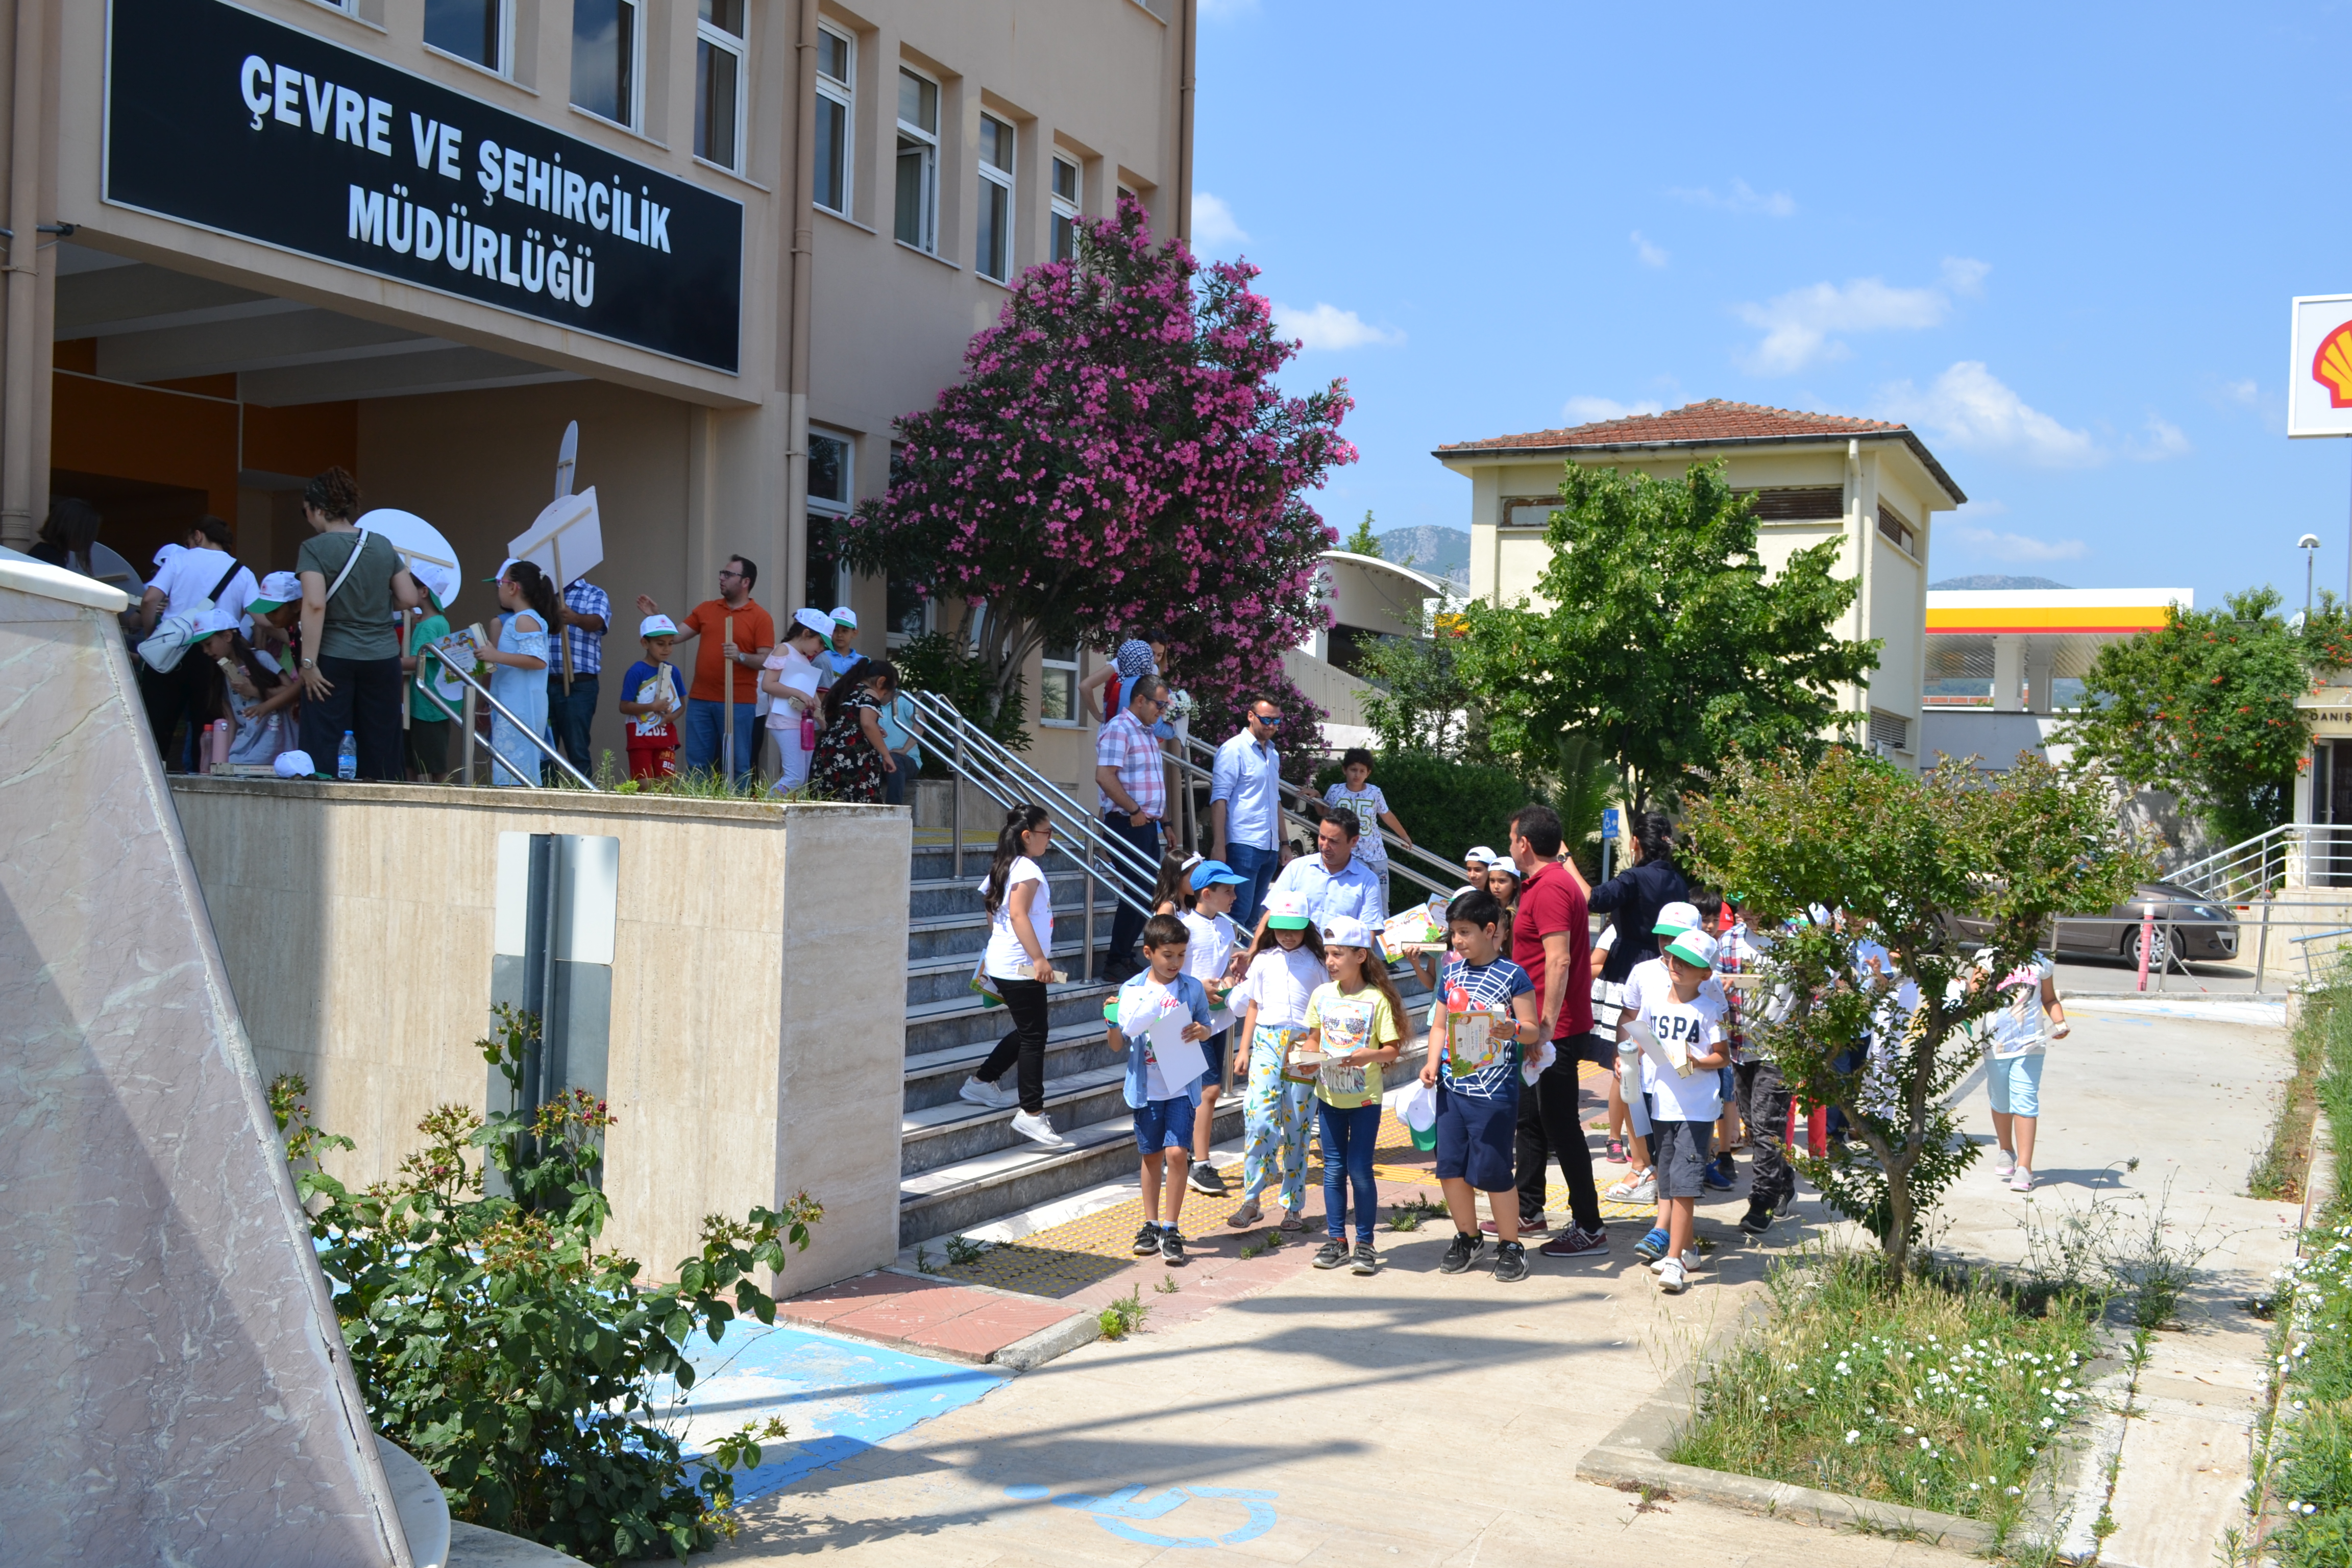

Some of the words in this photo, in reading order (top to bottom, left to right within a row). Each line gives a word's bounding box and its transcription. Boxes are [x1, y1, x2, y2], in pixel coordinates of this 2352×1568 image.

[241, 55, 393, 157] ÇEVRE
[410, 112, 462, 181] VE
[477, 140, 671, 254] ŞEHİRCİLİK
[349, 183, 595, 308] MÜDÜRLÜĞÜ
